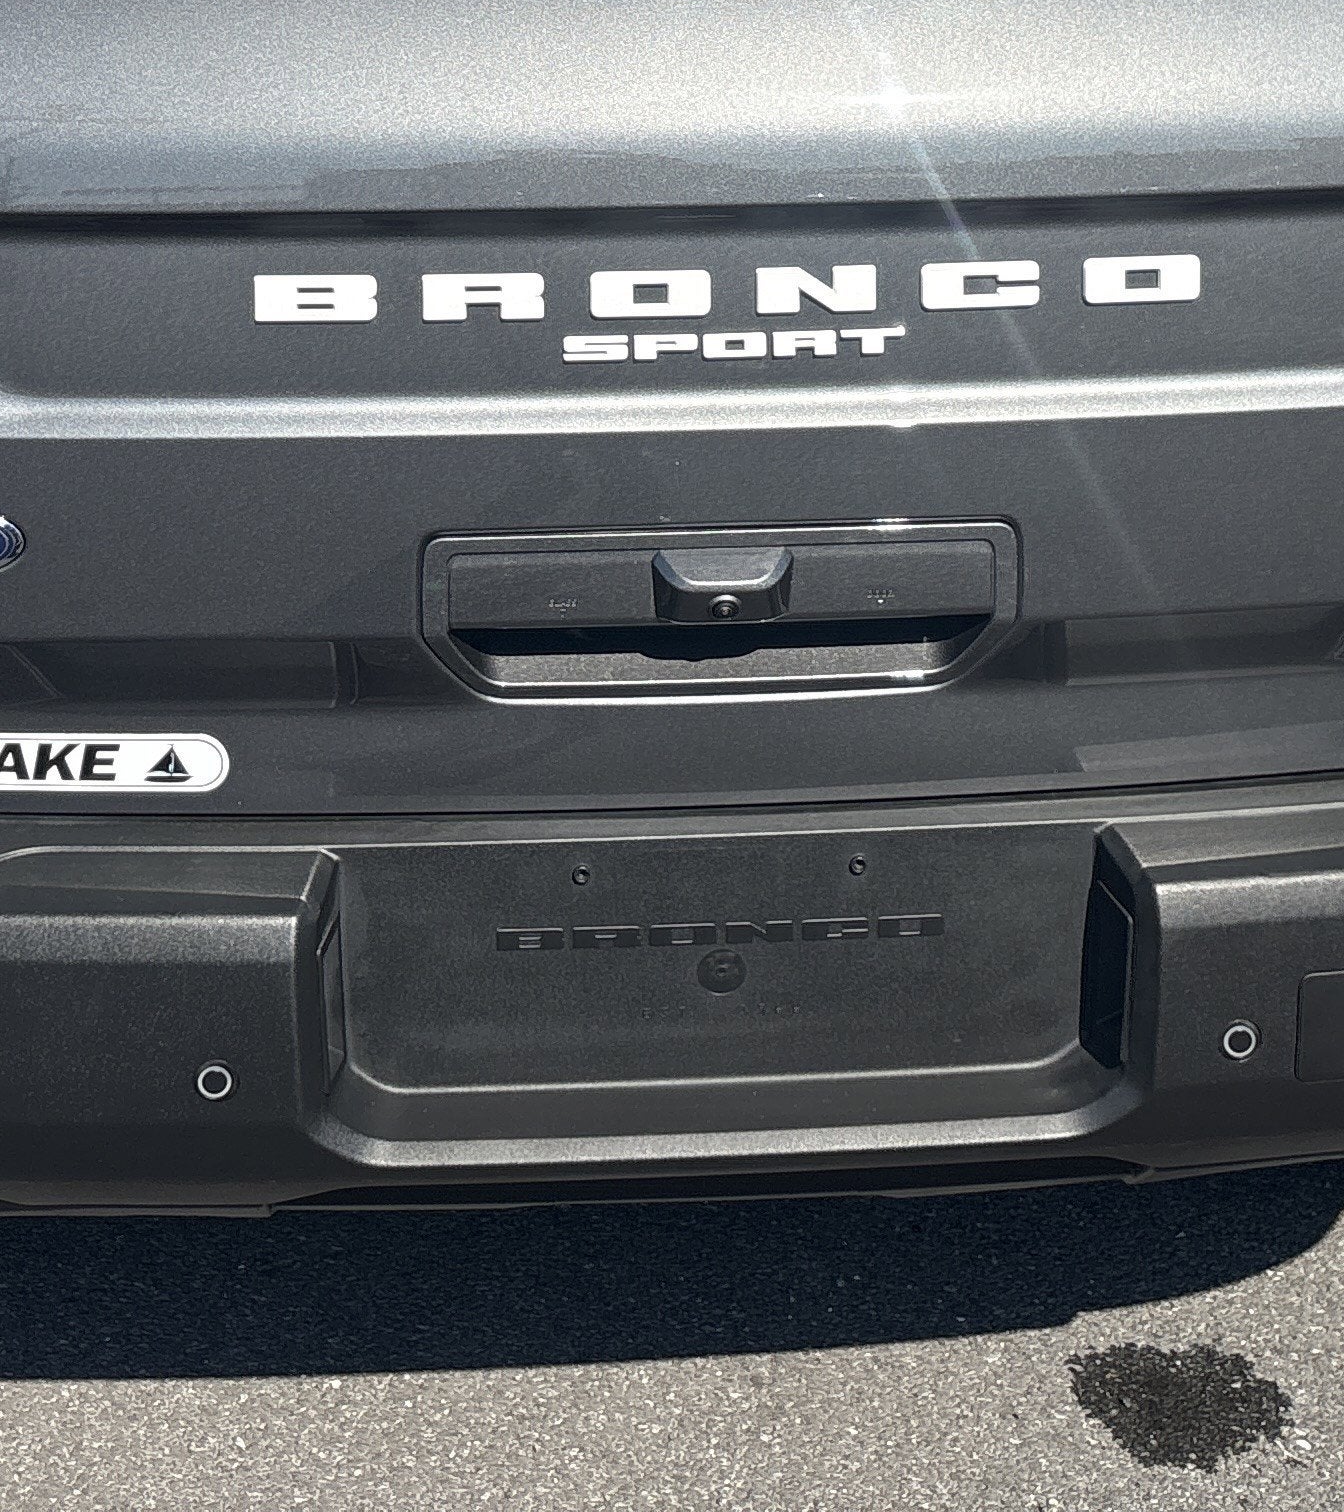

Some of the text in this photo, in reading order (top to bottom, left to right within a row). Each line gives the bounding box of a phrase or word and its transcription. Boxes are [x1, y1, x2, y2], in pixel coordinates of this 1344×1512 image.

[254, 254, 1202, 323] BRONCO
[562, 323, 907, 363] SPORT
[496, 913, 944, 951] BRONCO
